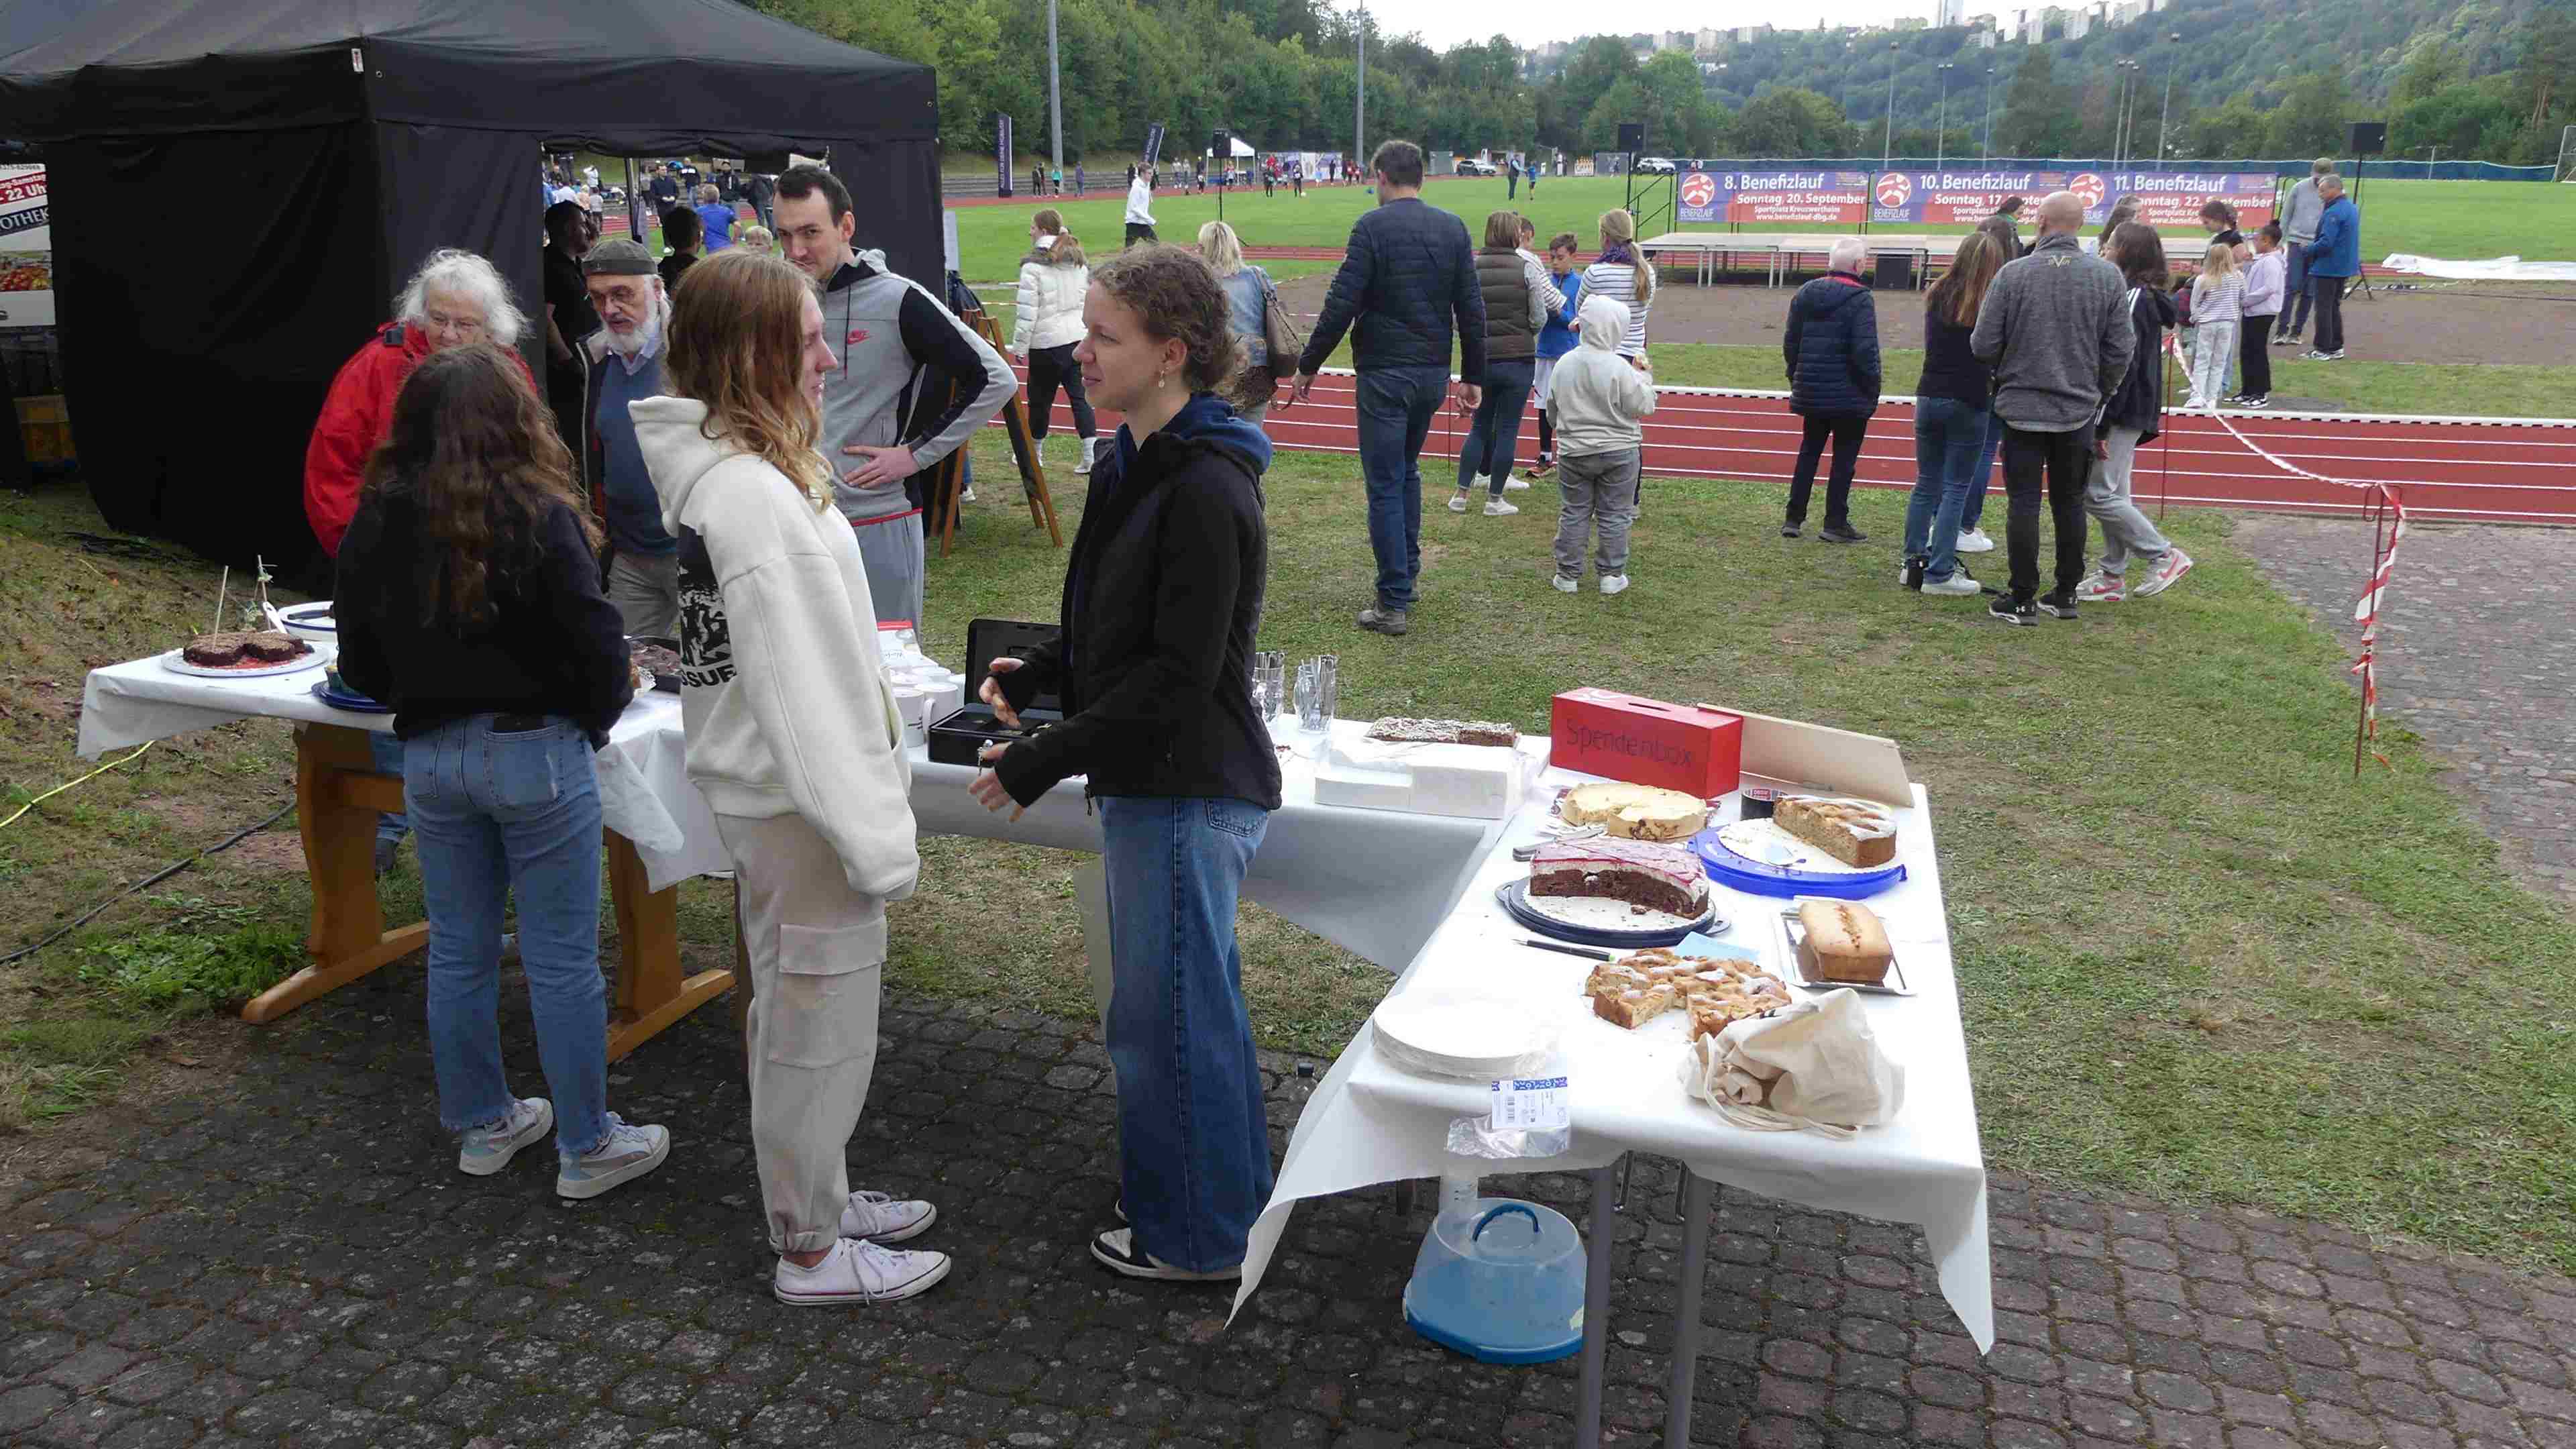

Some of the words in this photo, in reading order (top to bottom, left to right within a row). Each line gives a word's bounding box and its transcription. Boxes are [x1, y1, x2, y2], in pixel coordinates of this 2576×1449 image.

[1724, 176, 1738, 190] 8.
[1741, 173, 1825, 190] Benefizlauf
[1920, 175, 1939, 190] 10.
[1943, 173, 2031, 190] Benefizlauf
[2113, 176, 2130, 191] 11.
[2134, 174, 2227, 193] Benefizlauf
[5, 188, 25, 201] 22
[1786, 193, 1804, 204] 20.
[1805, 193, 1866, 206] September
[2184, 197, 2203, 207] 22.
[0, 207, 49, 229] OTHEK
[1566, 718, 1691, 767] Spendenbox
